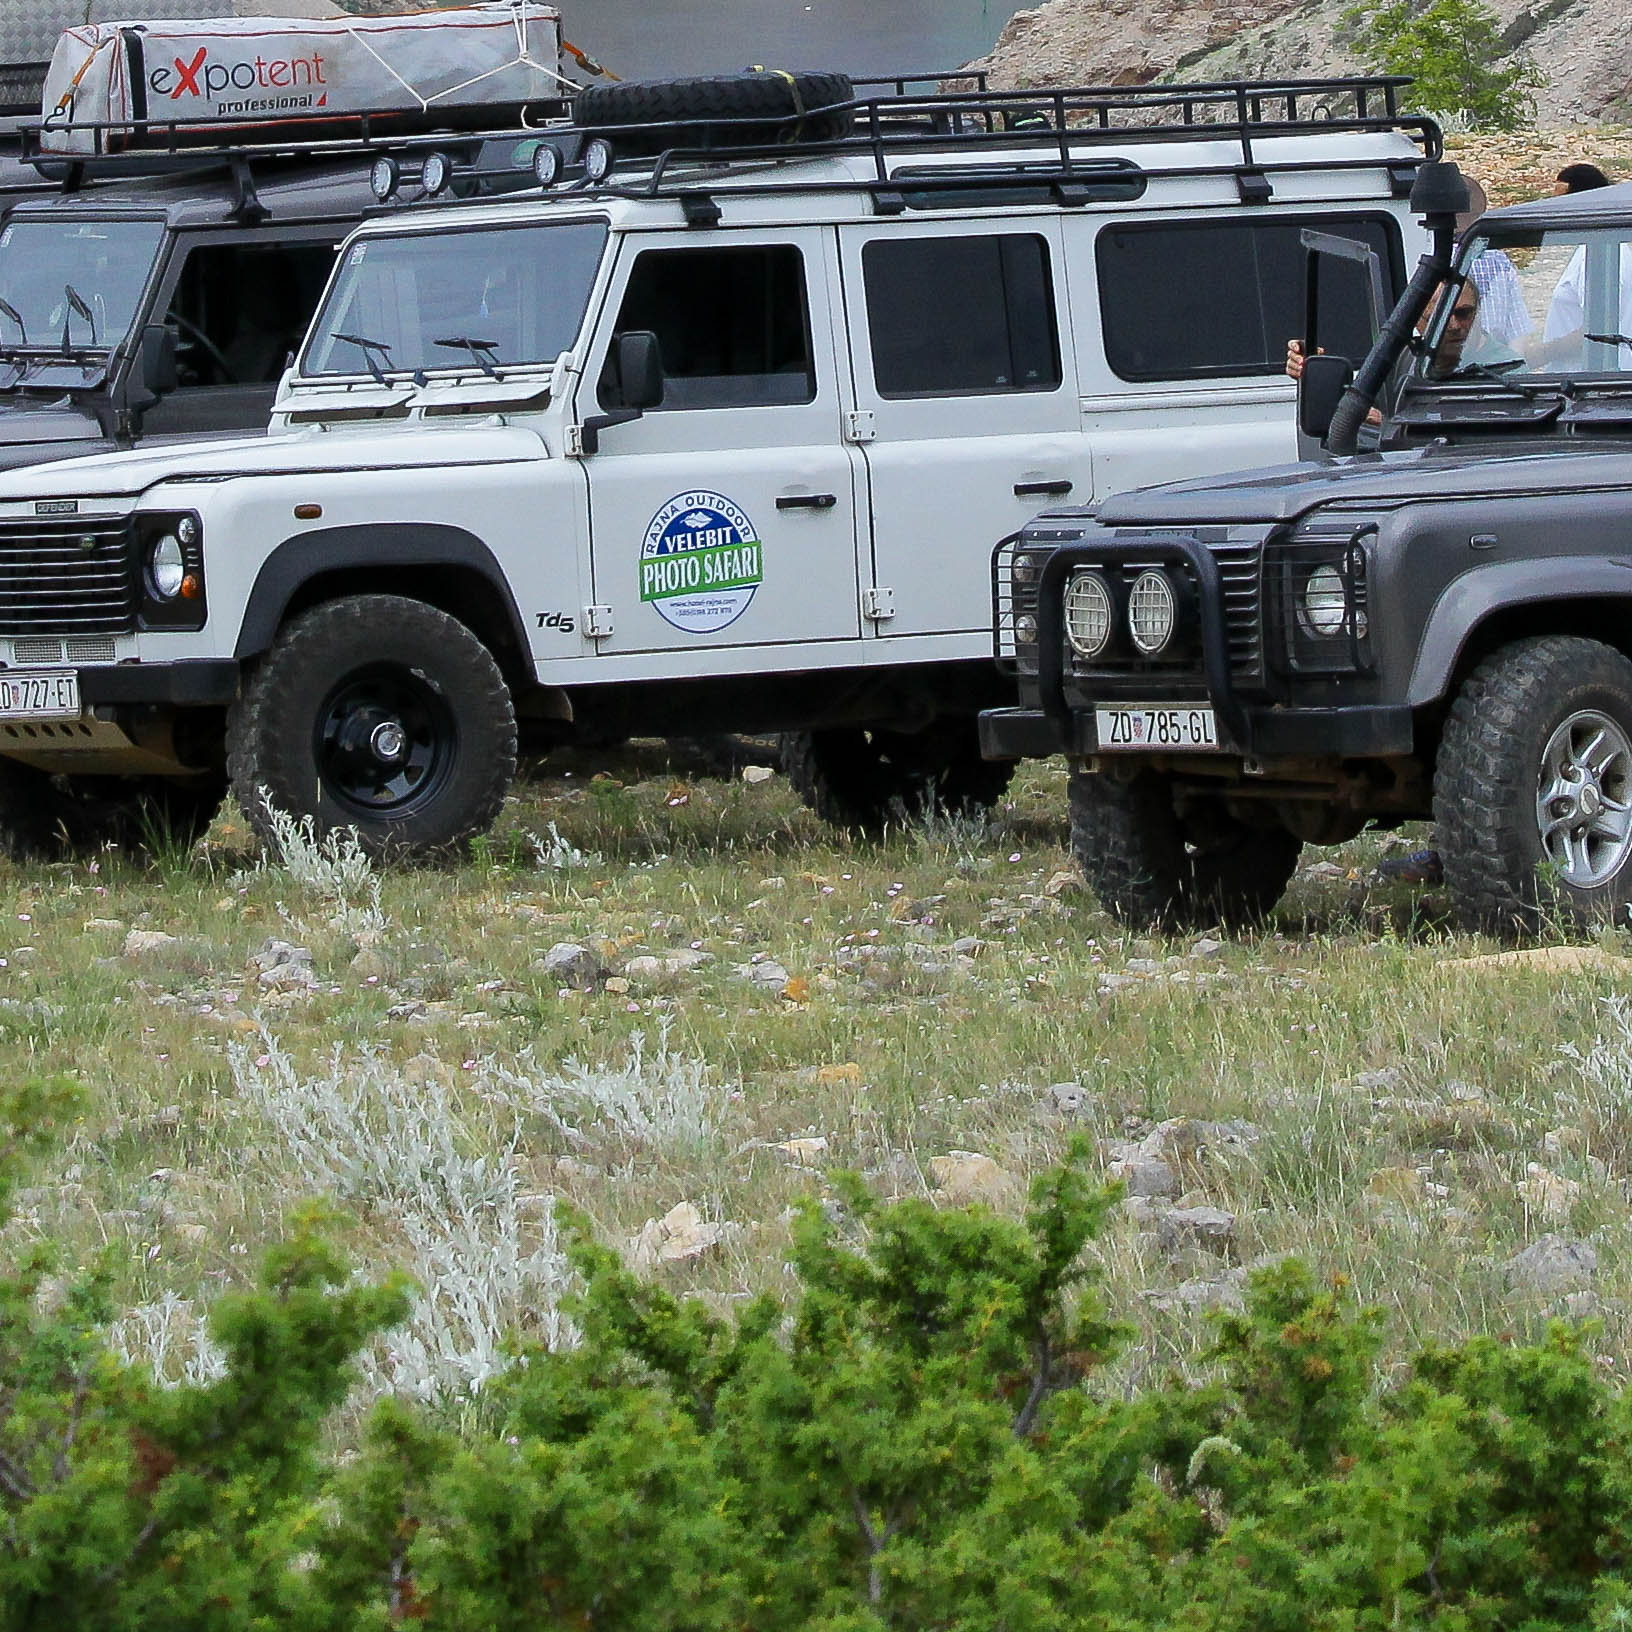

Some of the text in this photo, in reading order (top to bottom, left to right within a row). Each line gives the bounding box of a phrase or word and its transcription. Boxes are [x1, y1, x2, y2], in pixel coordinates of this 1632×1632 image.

[150, 47, 327, 100] eXpotent
[218, 94, 313, 116] professional
[646, 495, 751, 554] RAJNA OUTDOOR
[664, 526, 734, 554] VELEBIT
[643, 546, 759, 595] PHOTO SAFARI
[535, 612, 575, 633] Td5
